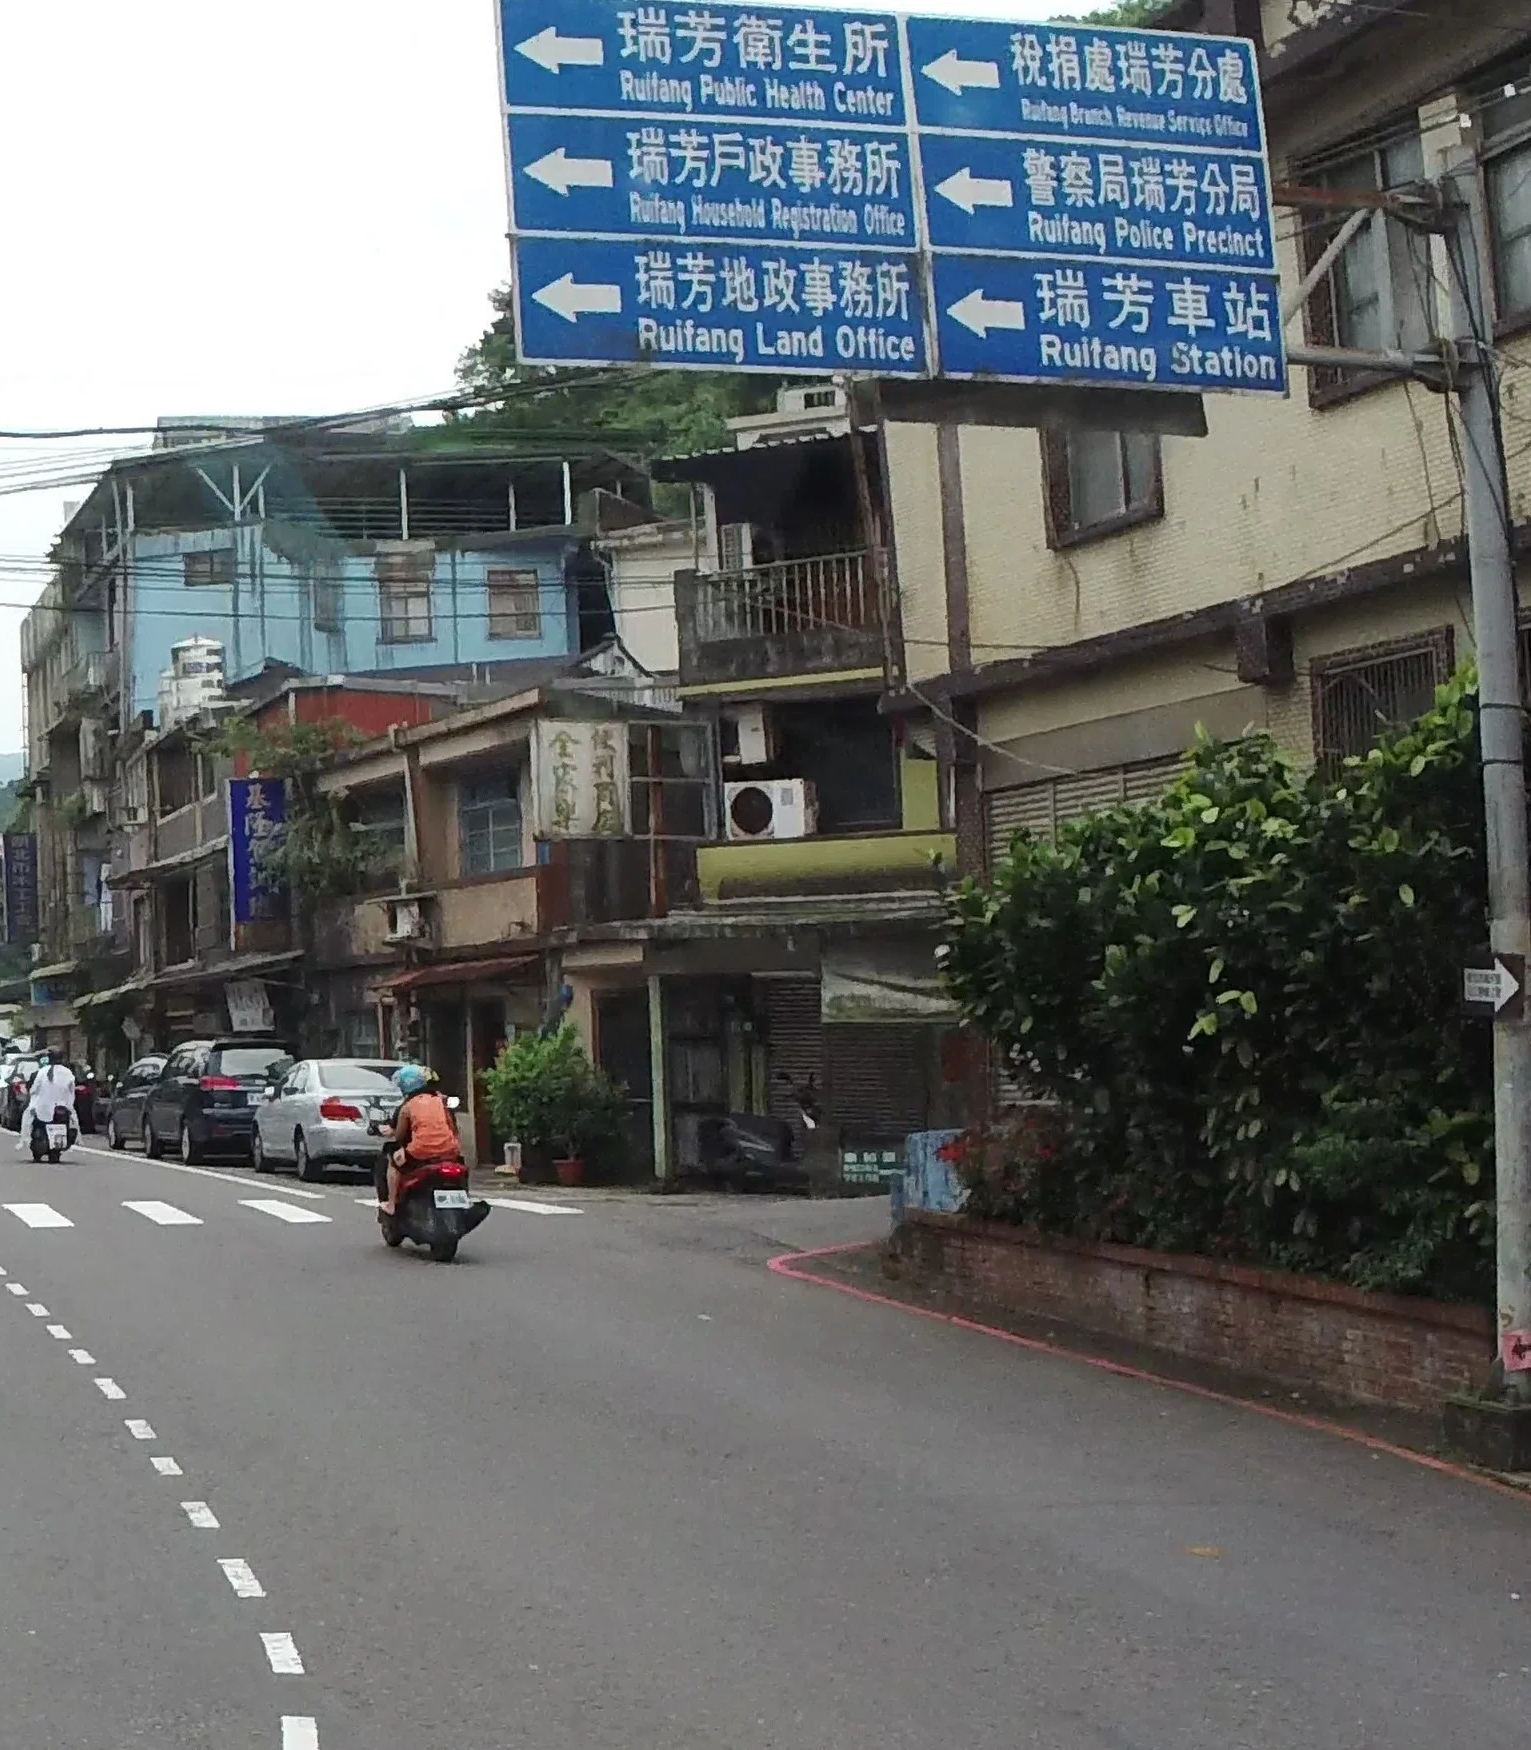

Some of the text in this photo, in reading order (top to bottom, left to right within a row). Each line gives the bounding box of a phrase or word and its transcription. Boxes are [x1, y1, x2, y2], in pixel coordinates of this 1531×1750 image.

[617, 8, 888, 77] 瑞芳衛生所
[620, 70, 893, 115] Ruifang Public Health Center
[626, 128, 900, 199] 瑞芳戶政事務所
[1022, 148, 1260, 222] 警察局瑞芳分局
[630, 192, 905, 238] Ruifang Household Registration Office
[1028, 211, 1264, 258] Ruifang Police Precinct
[635, 252, 909, 321] 瑞芳地政事務所
[1033, 269, 1271, 342] 瑞芳車站
[638, 317, 915, 363] Ruifang Land Office
[1040, 334, 1276, 381] Ruifang Station
